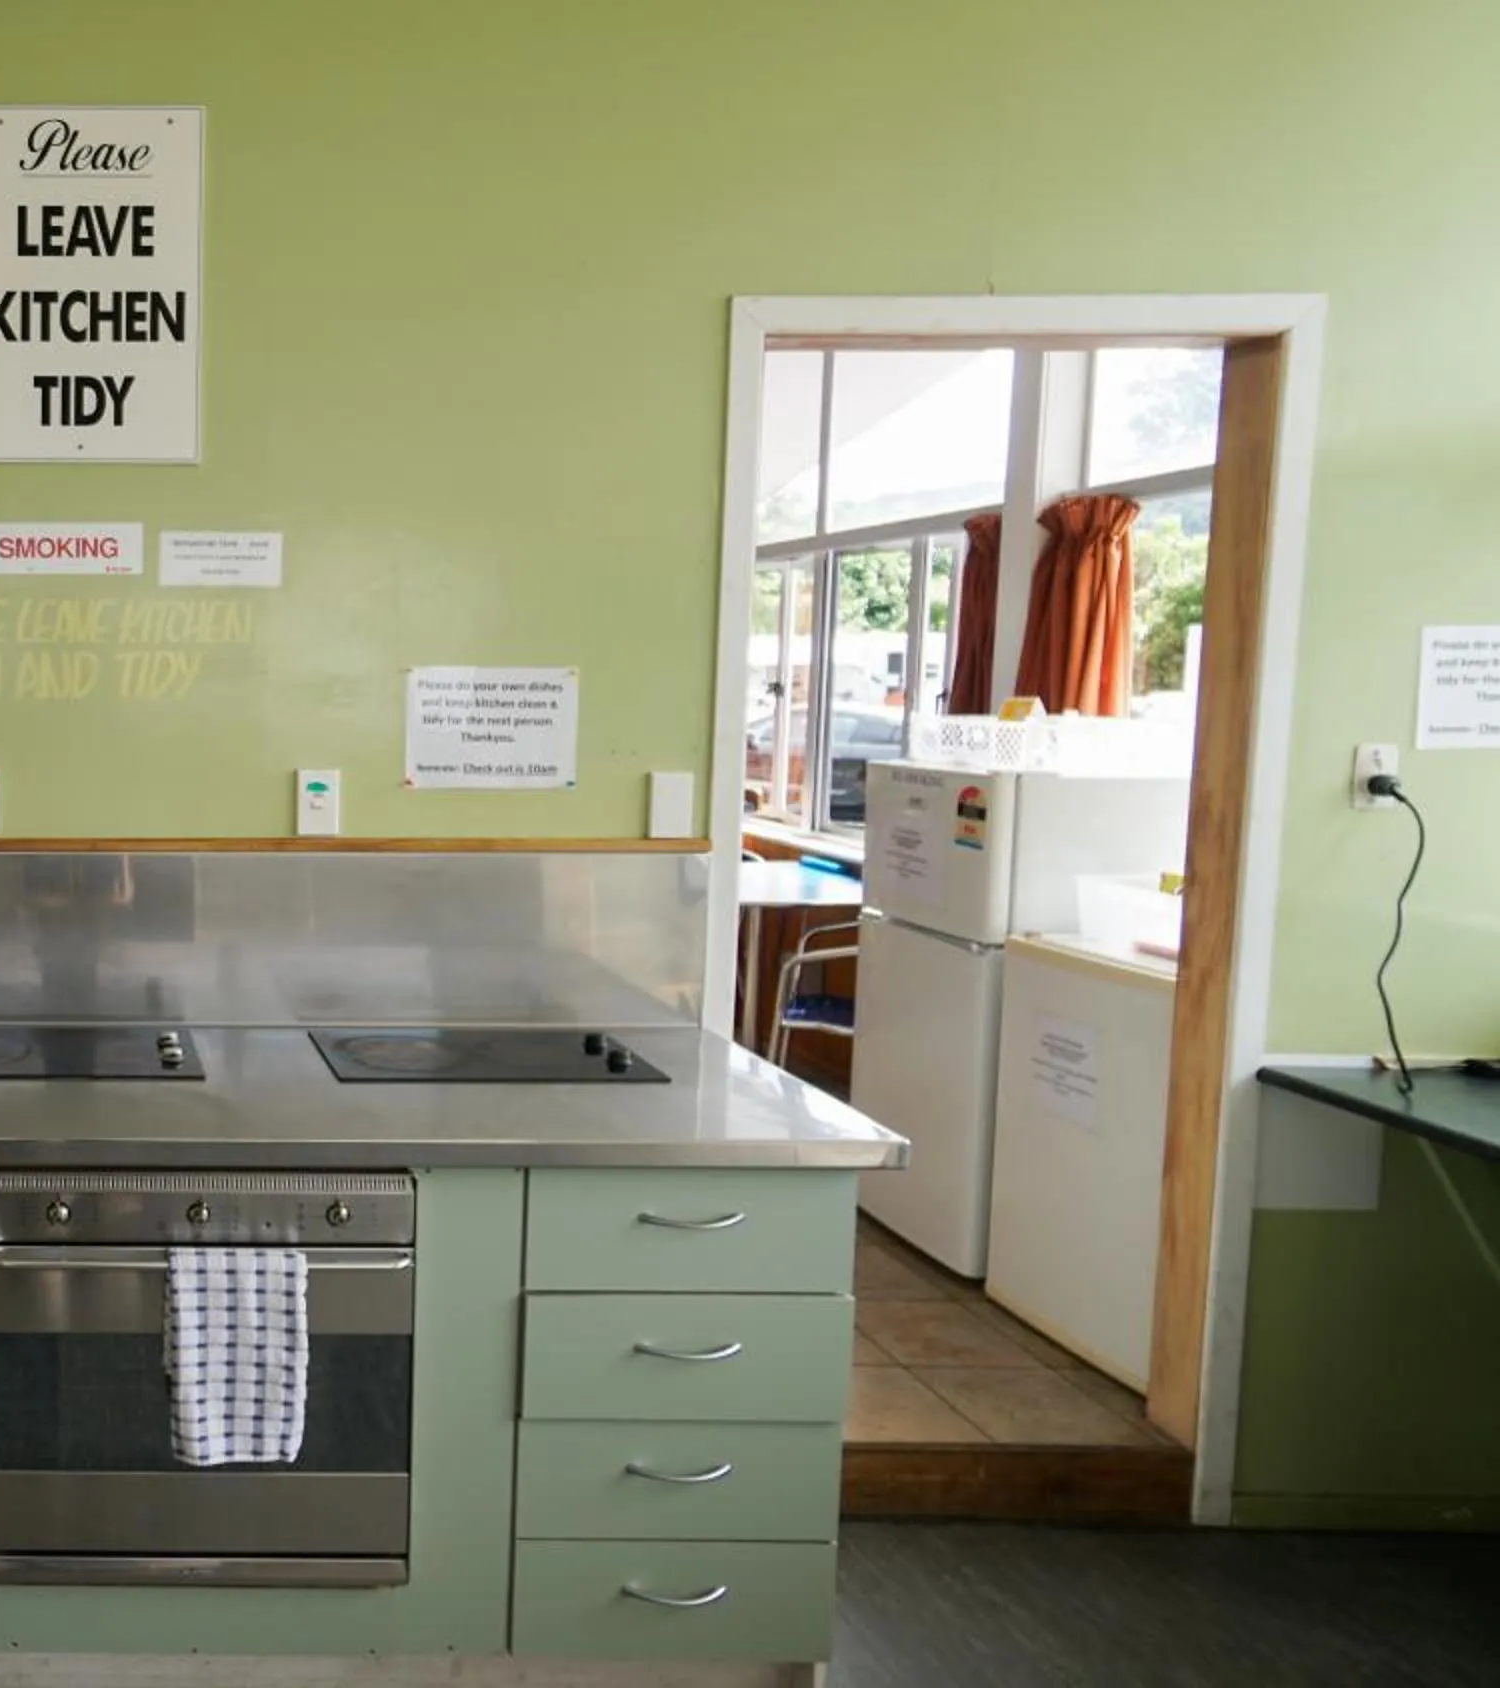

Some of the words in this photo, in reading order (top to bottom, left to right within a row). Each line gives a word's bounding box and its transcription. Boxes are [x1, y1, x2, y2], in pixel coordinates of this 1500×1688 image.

[19, 119, 151, 172] Please
[17, 205, 155, 257] LEAVE
[33, 375, 135, 427] TIDY
[0, 537, 120, 560] SMOKING
[16, 597, 119, 644] LEAVE
[118, 600, 254, 644] KITCHEN
[14, 651, 100, 700] AND
[116, 652, 201, 698] TIDY
[418, 680, 453, 691] Please
[455, 680, 471, 691] do
[473, 683, 499, 694] your
[501, 684, 525, 692] own
[528, 680, 563, 693] dishes
[421, 698, 442, 708] and
[474, 698, 515, 709] kitchen
[517, 698, 547, 709] clean
[466, 715, 484, 725] the
[463, 763, 493, 775] Check
